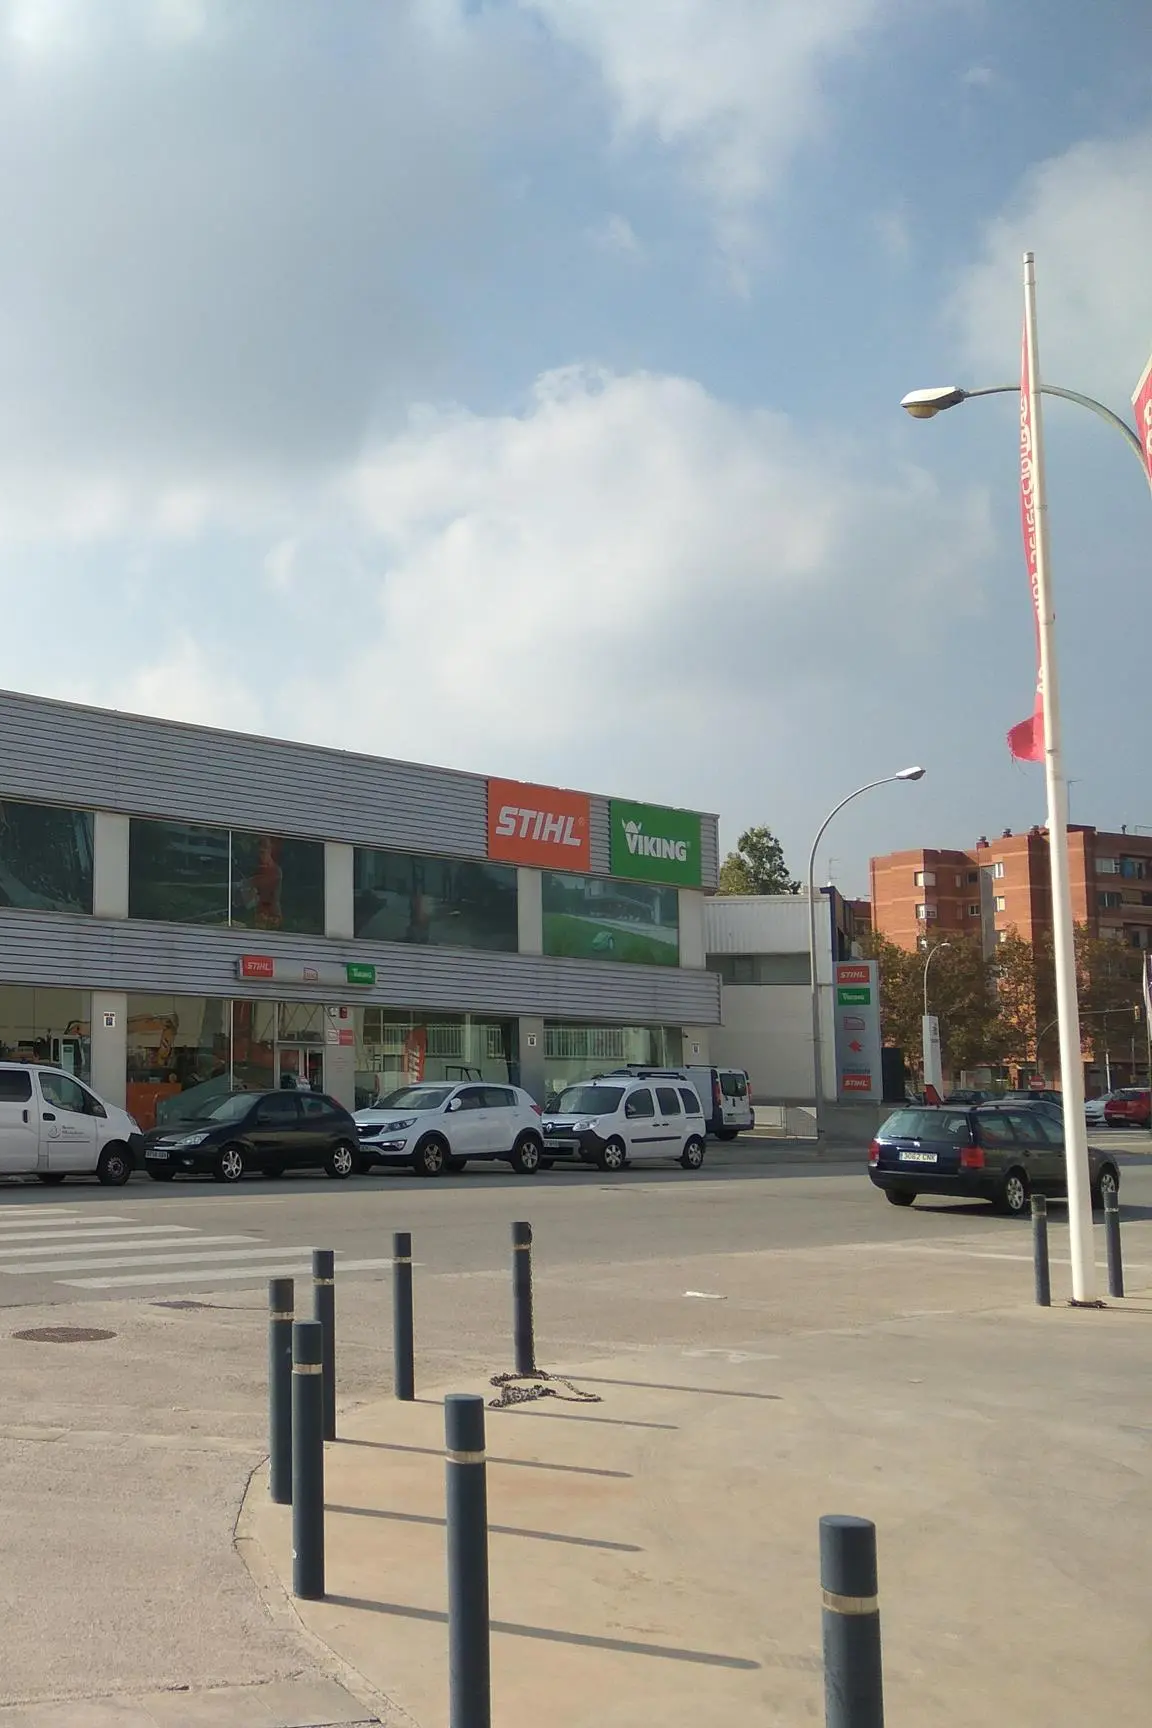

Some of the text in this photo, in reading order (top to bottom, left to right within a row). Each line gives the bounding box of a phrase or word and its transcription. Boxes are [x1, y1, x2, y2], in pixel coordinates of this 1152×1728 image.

[496, 806, 581, 846] STIHL
[625, 832, 686, 862] VIKING
[248, 962, 272, 971] STIHL
